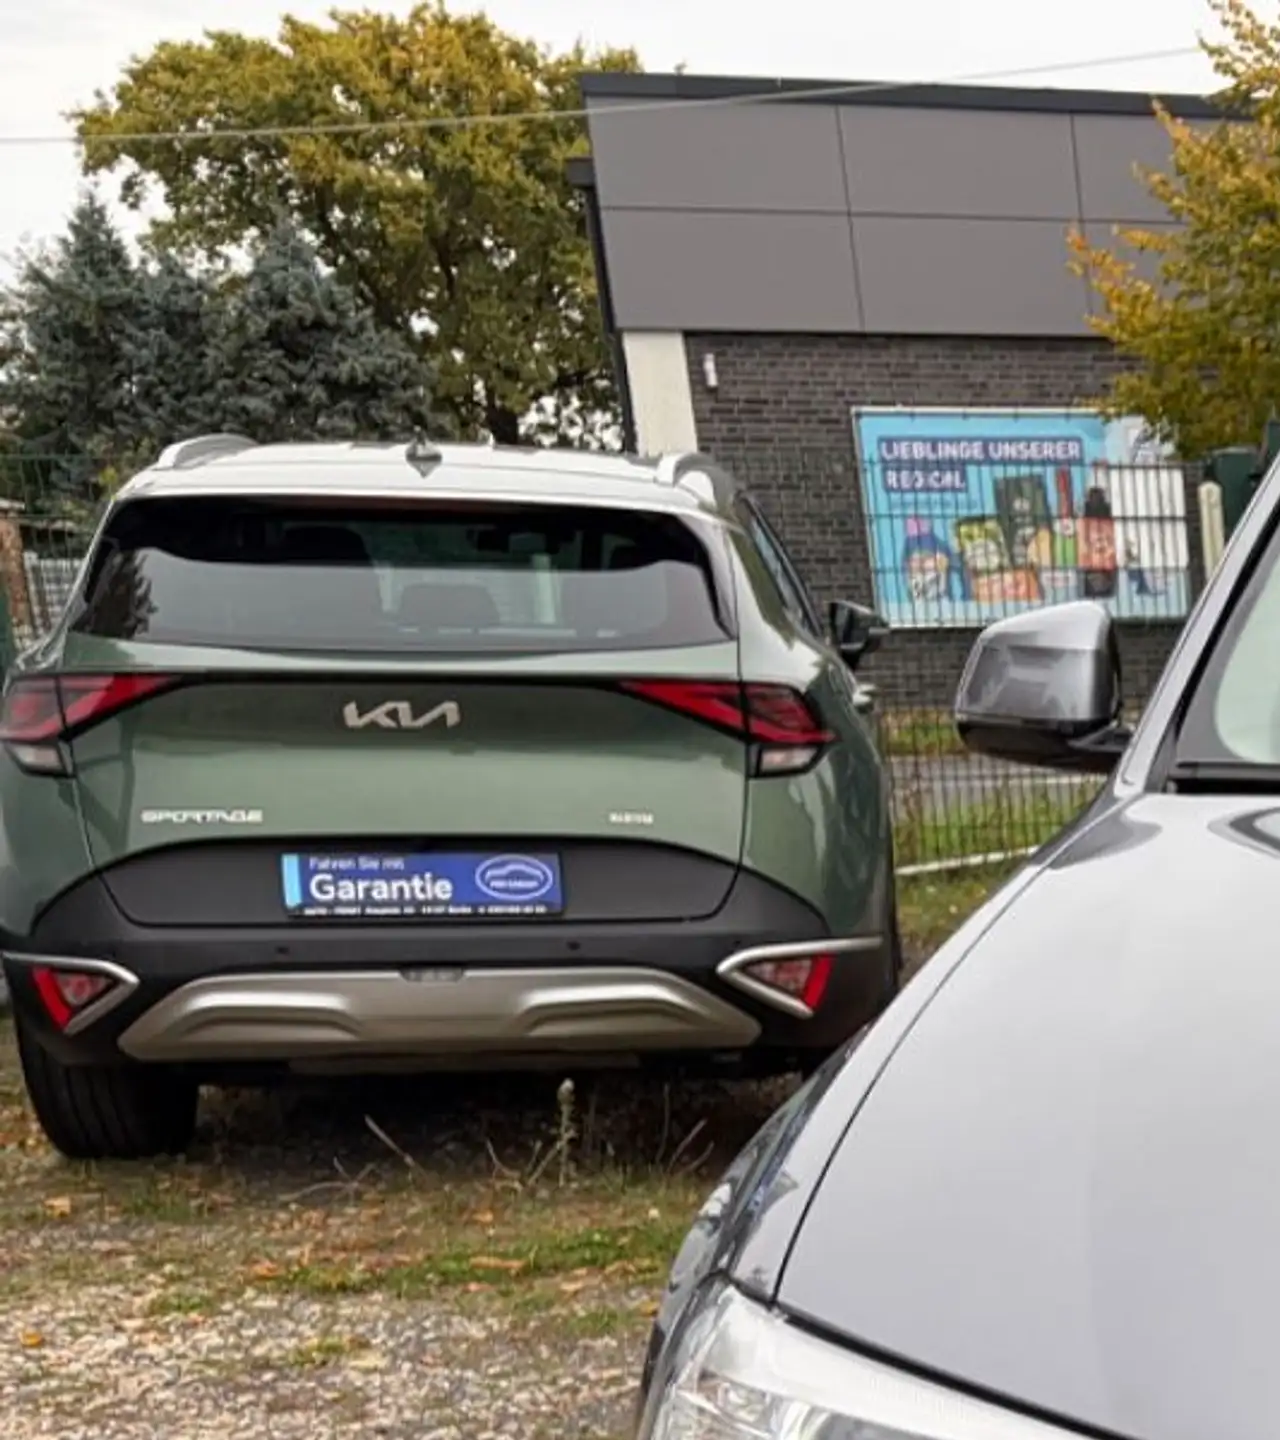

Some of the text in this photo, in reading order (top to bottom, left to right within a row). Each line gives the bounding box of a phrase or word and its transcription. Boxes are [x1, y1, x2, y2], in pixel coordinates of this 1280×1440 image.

[880, 440, 1080, 461] LIEBLINGE UNSERER
[343, 700, 460, 728] KIA
[309, 872, 453, 901] Garantie
